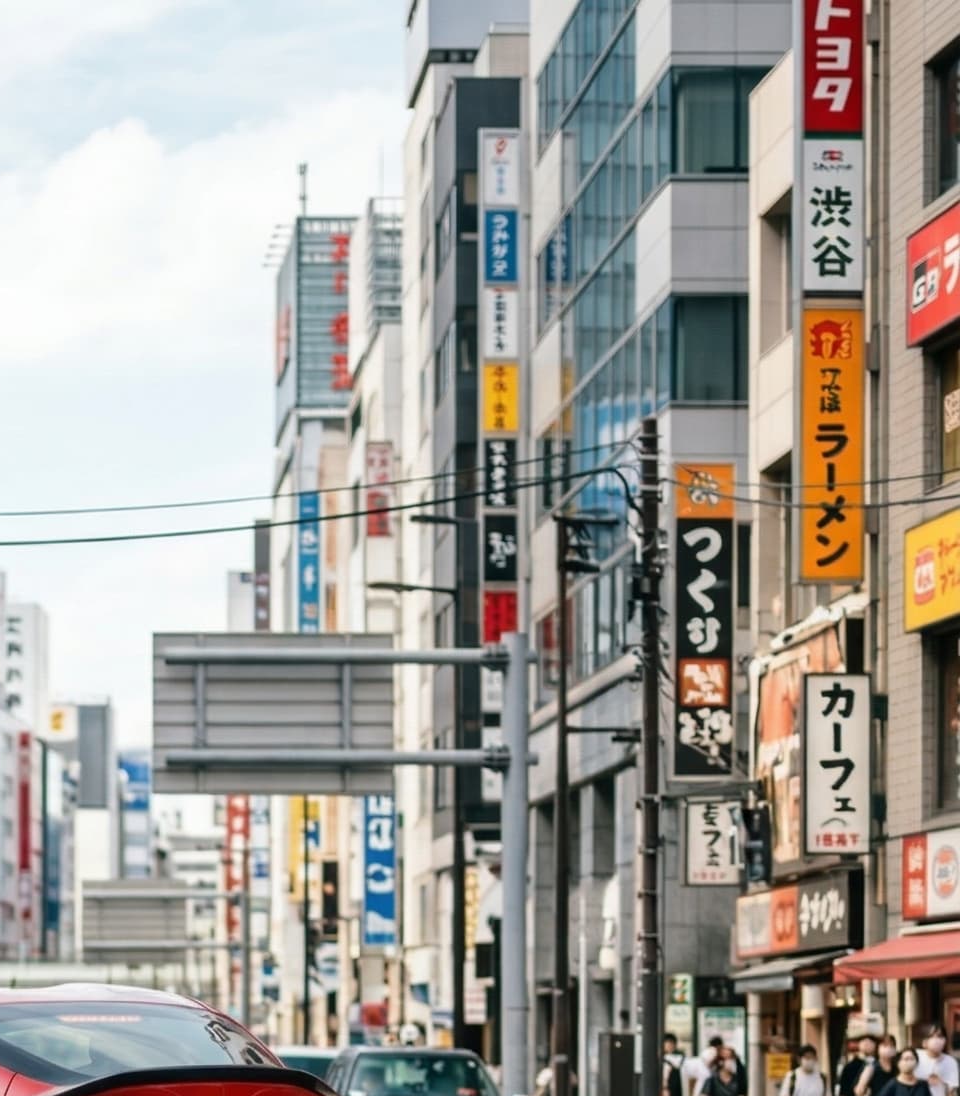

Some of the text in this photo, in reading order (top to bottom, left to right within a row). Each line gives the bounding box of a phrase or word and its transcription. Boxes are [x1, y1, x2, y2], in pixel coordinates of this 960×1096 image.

[809, 185, 854, 277] 渋谷
[815, 423, 849, 567] ラーメン
[819, 682, 856, 812] カーフェ
